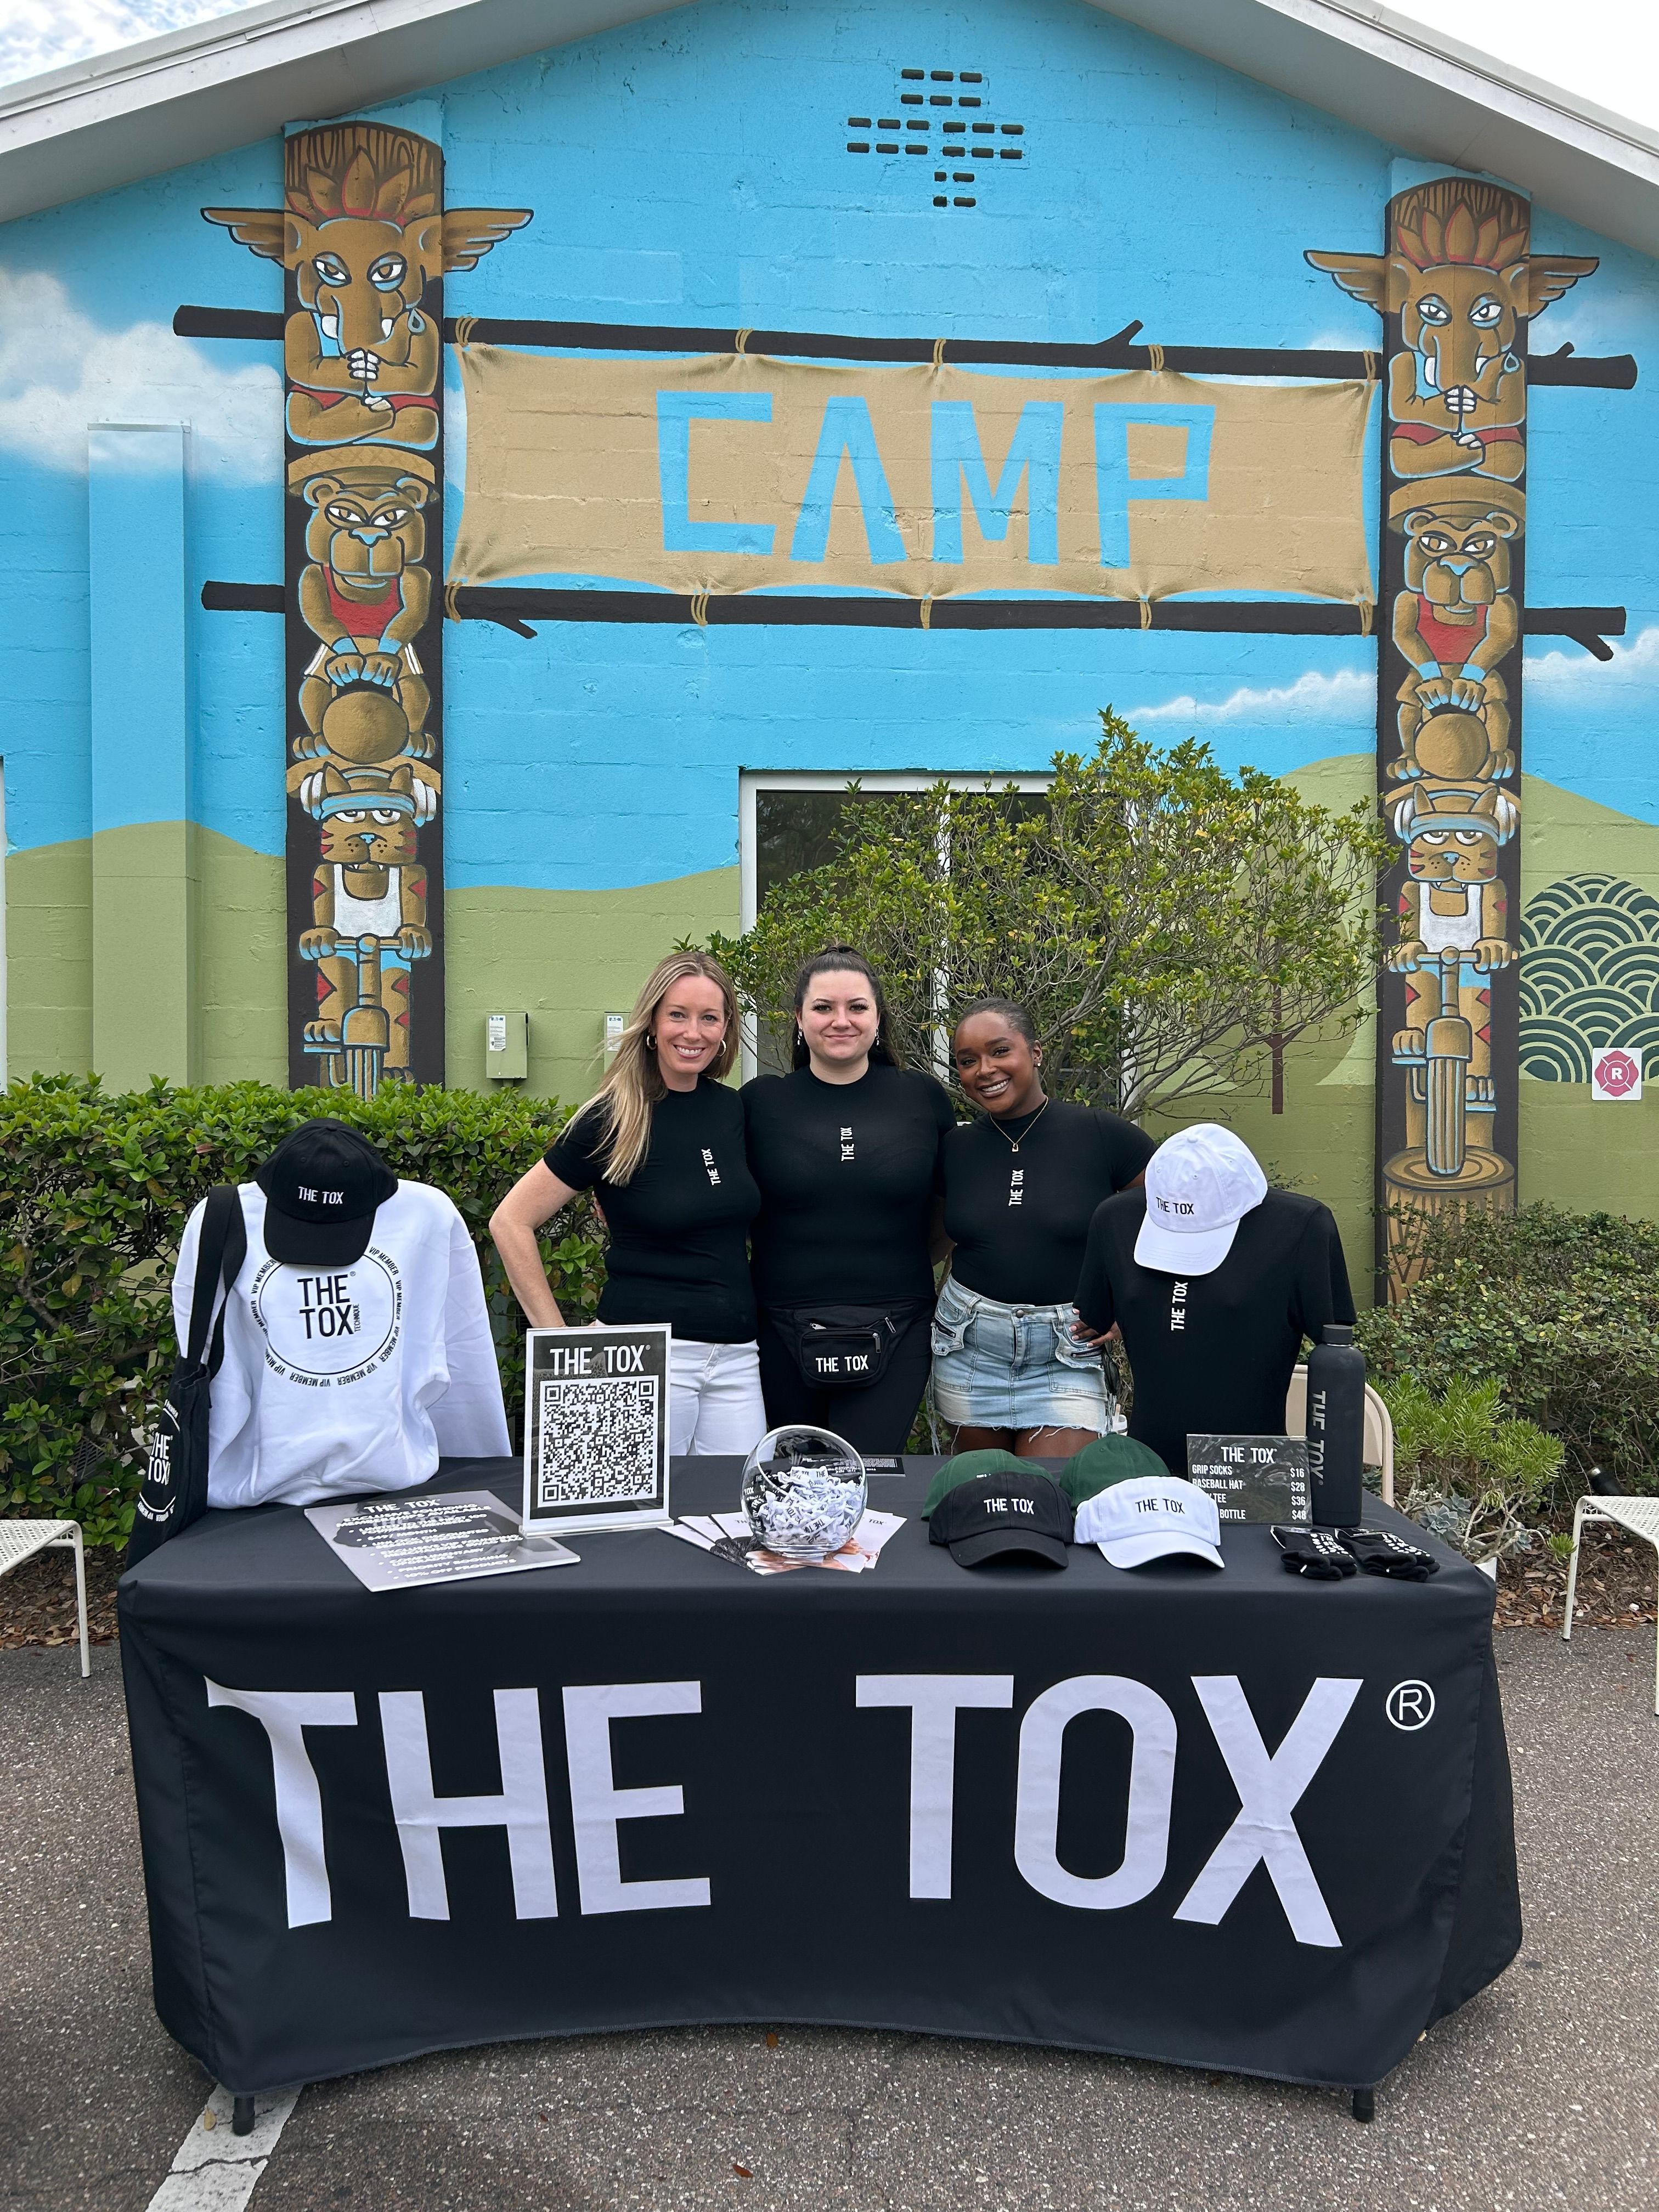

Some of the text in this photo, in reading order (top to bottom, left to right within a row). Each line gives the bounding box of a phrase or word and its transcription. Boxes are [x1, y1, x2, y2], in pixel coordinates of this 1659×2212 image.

[657, 391, 1215, 569] CAMP
[1611, 1068, 1623, 1080] R
[840, 1127, 854, 1161] THE TOX
[701, 1149, 721, 1186] THE TOX
[298, 1186, 344, 1204] THE TOX
[1008, 1170, 1024, 1206] THE TOX
[1156, 1197, 1194, 1215] THE TOX
[369, 1246, 399, 1276] VIP MEMBER
[1171, 1281, 1188, 1331] THE TOX
[299, 1304, 354, 1339] TOX
[550, 1347, 592, 1375] THE
[816, 1355, 869, 1372] THE TOX
[1312, 1390, 1326, 1430] THE
[1221, 1446, 1245, 1463] THE
[148, 1456, 170, 1486] TOX
[1192, 1464, 1305, 1478] GRIP SOCKS $16
[1192, 1479, 1305, 1492] BASEBALL HAT $28
[364, 1504, 399, 1513] THE
[983, 1498, 1034, 1515] THE TOX
[1135, 1498, 1185, 1515] THE TOX
[1213, 1493, 1227, 1503] TEE
[1291, 1496, 1306, 1506] $36
[1220, 1510, 1306, 1520] BOTTLE $48
[204, 1674, 712, 1929] THE
